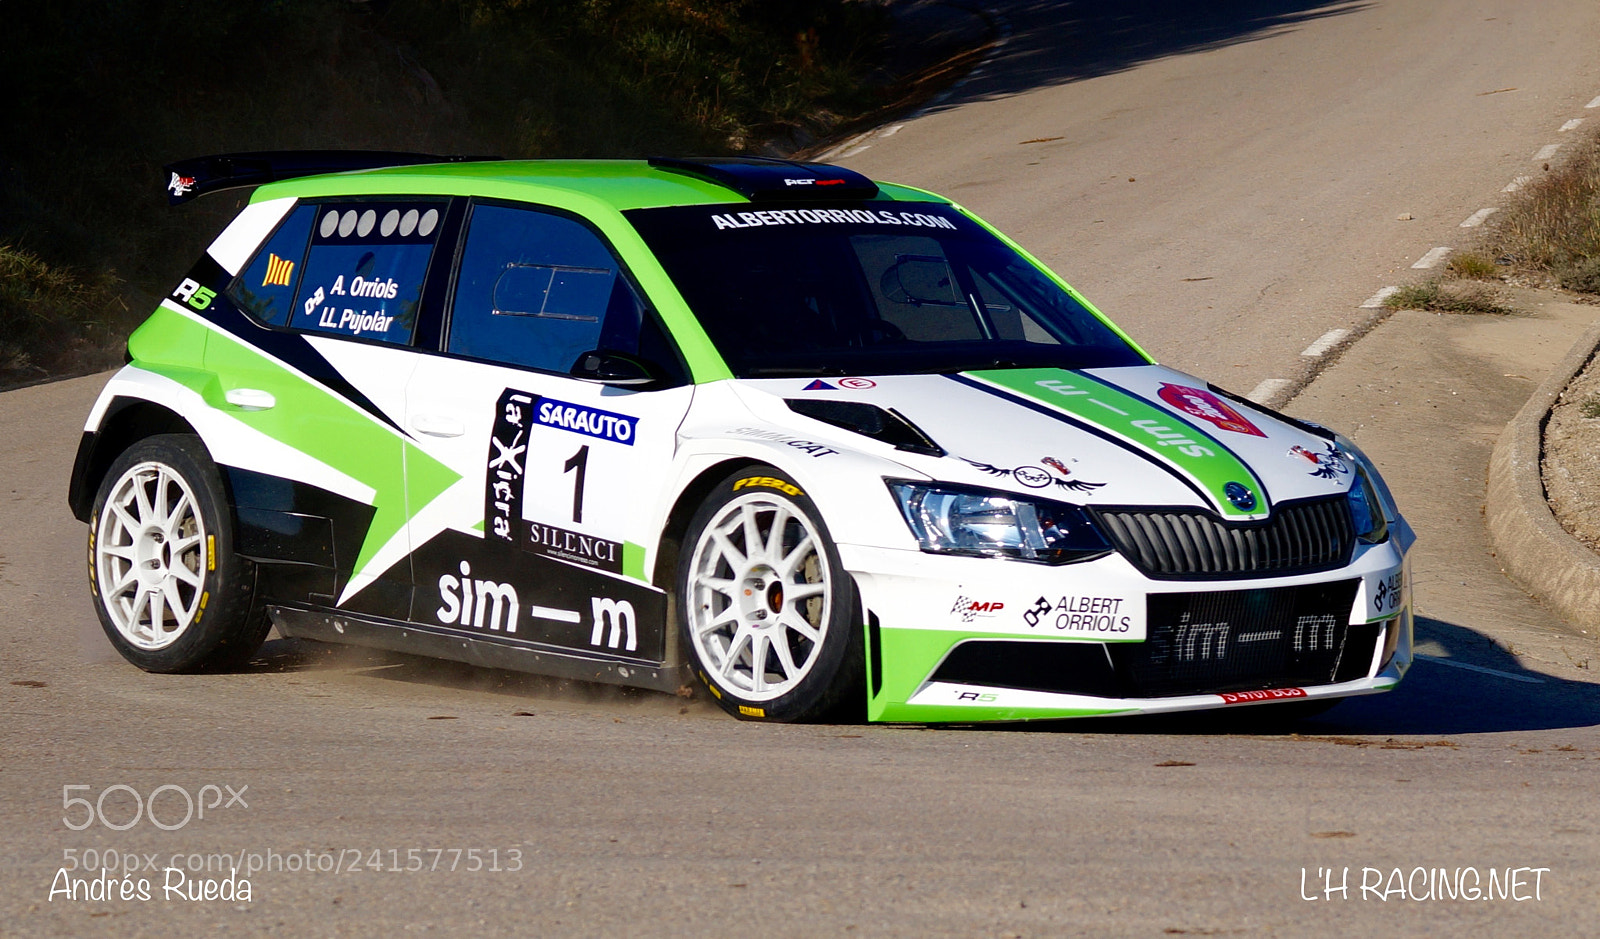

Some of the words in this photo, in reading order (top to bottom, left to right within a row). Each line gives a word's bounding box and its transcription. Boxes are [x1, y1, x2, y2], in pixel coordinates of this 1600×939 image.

[711, 207, 957, 230] ALBERTORRIOLS.COM
[172, 277, 218, 310] R5
[329, 274, 346, 296] A.
[350, 276, 399, 299] Orriols
[505, 394, 532, 428] la
[539, 402, 631, 441] SARAUTO
[563, 444, 590, 525] 1
[530, 523, 615, 562] SILENCI
[436, 560, 520, 633] sim
[590, 596, 638, 652] m
[1055, 596, 1124, 615] ALBERT
[1055, 613, 1131, 633] ORRIOLS
[958, 691, 999, 702] R5
